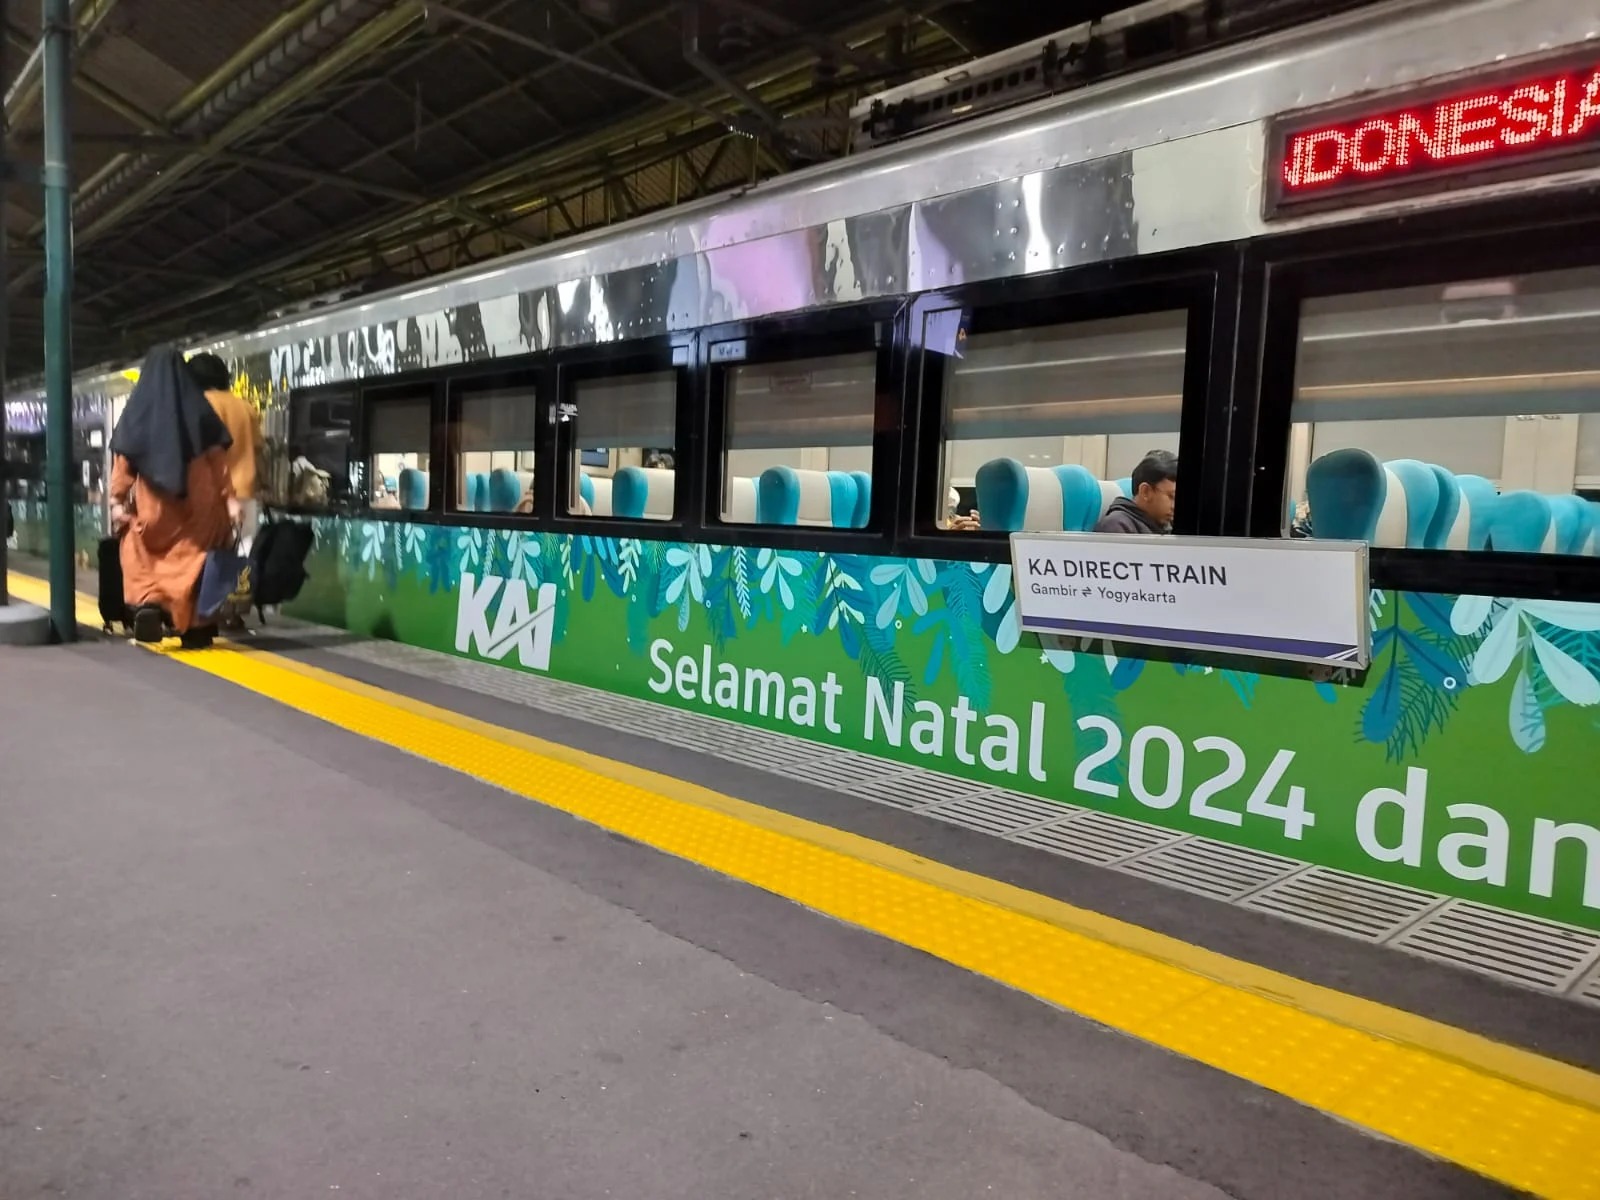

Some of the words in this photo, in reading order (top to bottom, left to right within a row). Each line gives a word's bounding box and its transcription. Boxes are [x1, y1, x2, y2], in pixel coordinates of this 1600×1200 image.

[1028, 558, 1057, 577] KA
[1064, 559, 1143, 581] DIRECT
[1150, 563, 1227, 586] TRAIN
[1031, 583, 1078, 598] Gambir
[1097, 586, 1176, 604] Yogyakarta
[455, 572, 557, 671] KAI
[648, 638, 842, 735] Selamat
[863, 676, 1047, 782] Natal
[1073, 715, 1315, 841] 2024
[1355, 766, 1600, 910] dan
